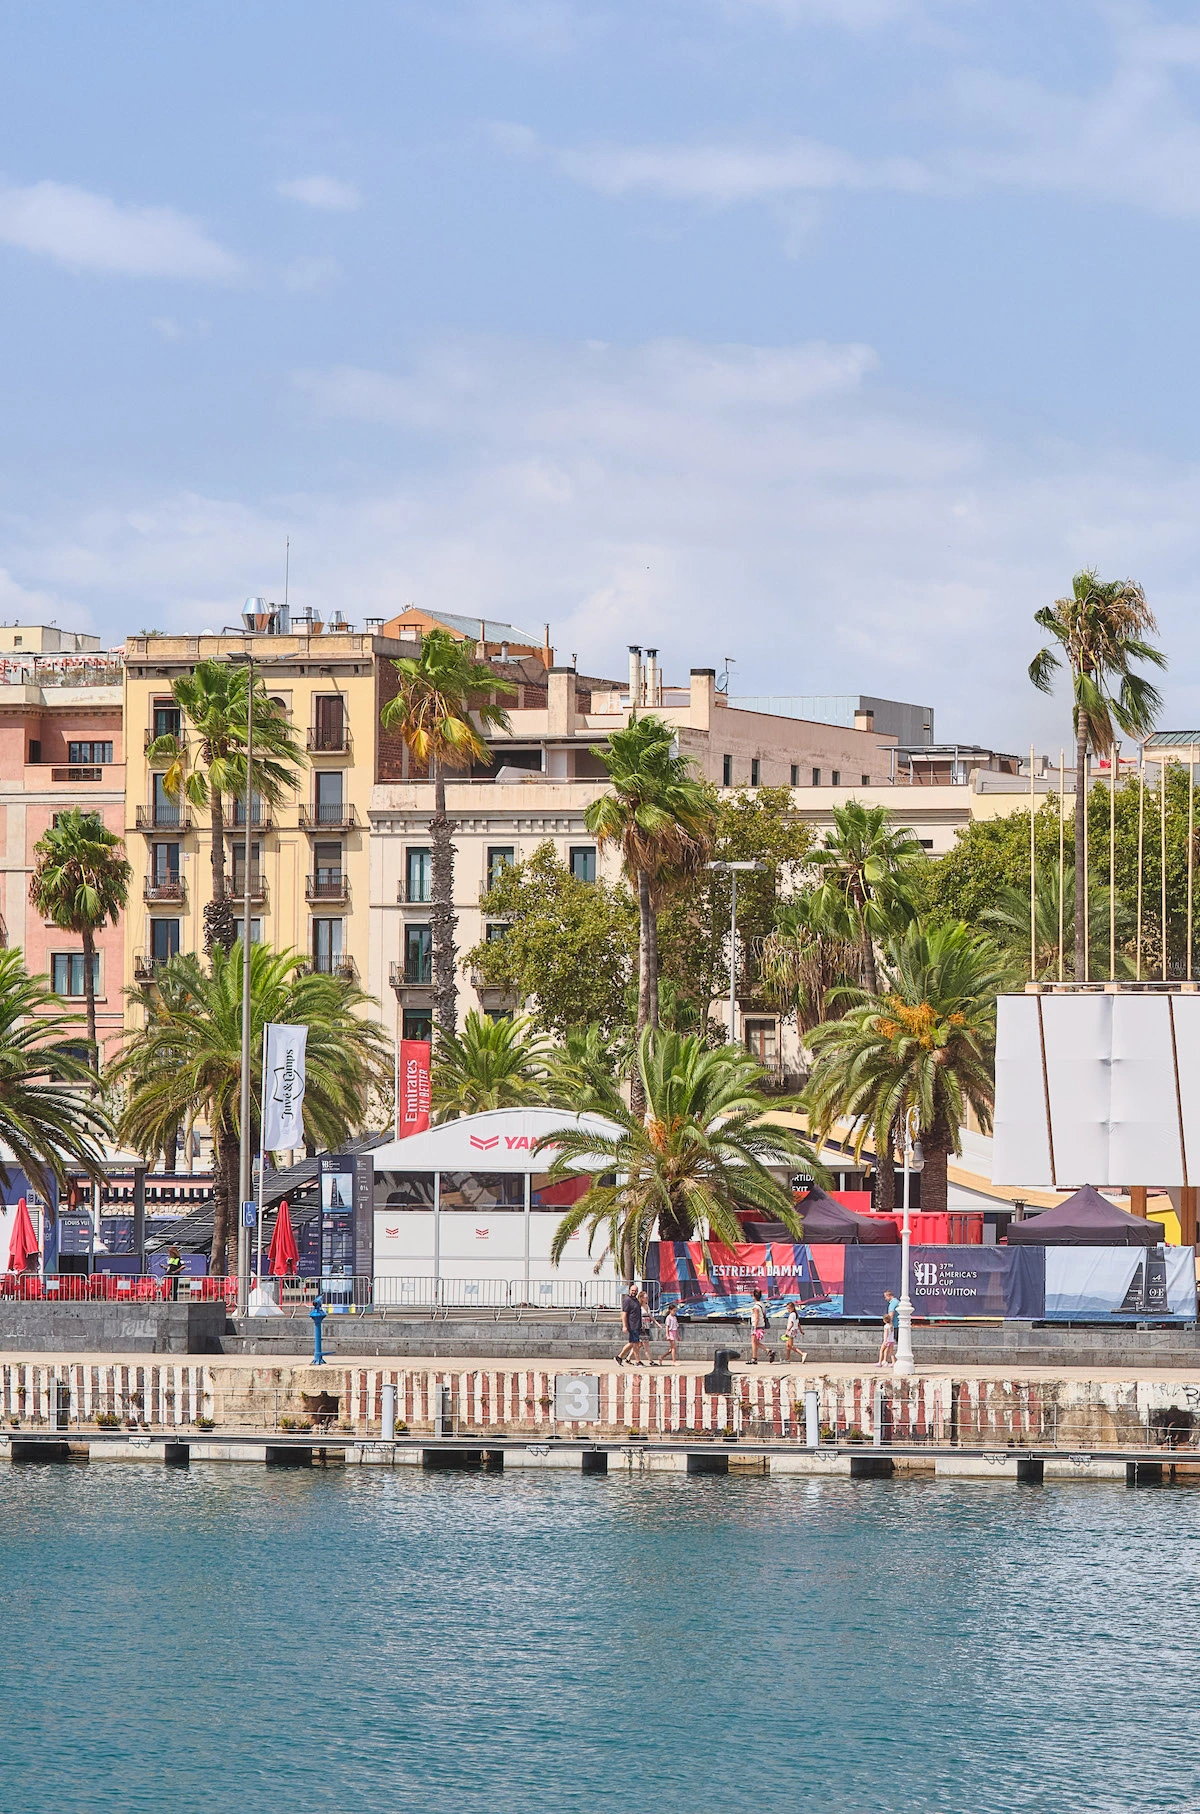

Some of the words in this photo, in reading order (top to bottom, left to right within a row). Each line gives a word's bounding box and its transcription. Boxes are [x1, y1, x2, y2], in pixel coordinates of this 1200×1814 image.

[405, 1059, 418, 1123] Emirates
[419, 1069, 430, 1098] BETTER
[419, 1098, 429, 1113] FLY
[712, 1265, 765, 1277] ESTRELLA
[767, 1265, 803, 1277] DAMM
[915, 1288, 940, 1296] LOUIS
[941, 1288, 977, 1296] VUITTON
[565, 1380, 590, 1417] 3
